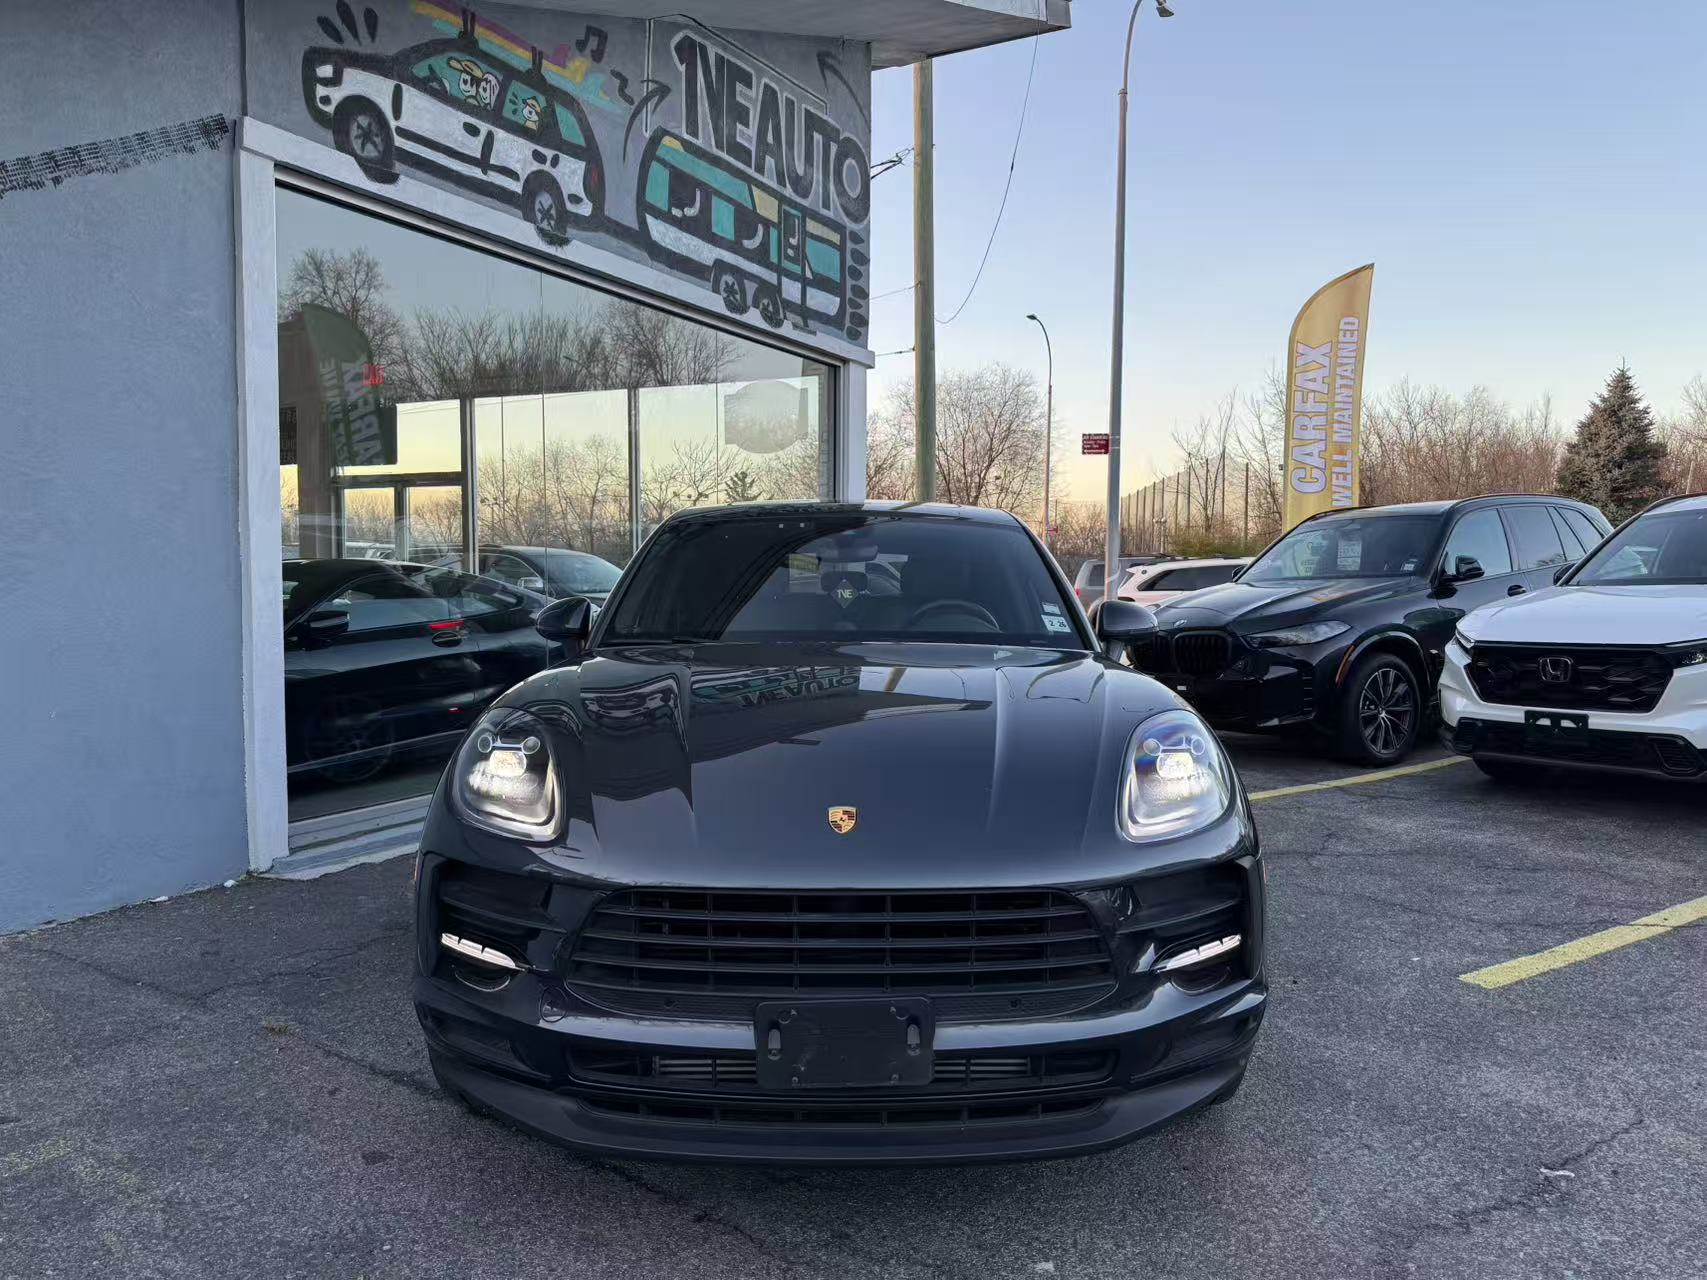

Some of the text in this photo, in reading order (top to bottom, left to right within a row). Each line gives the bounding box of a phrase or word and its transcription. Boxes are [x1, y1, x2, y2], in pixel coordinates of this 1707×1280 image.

[1290, 340, 1333, 494] CARFAX
[1331, 316, 1360, 507] WELL MAINTAINED
